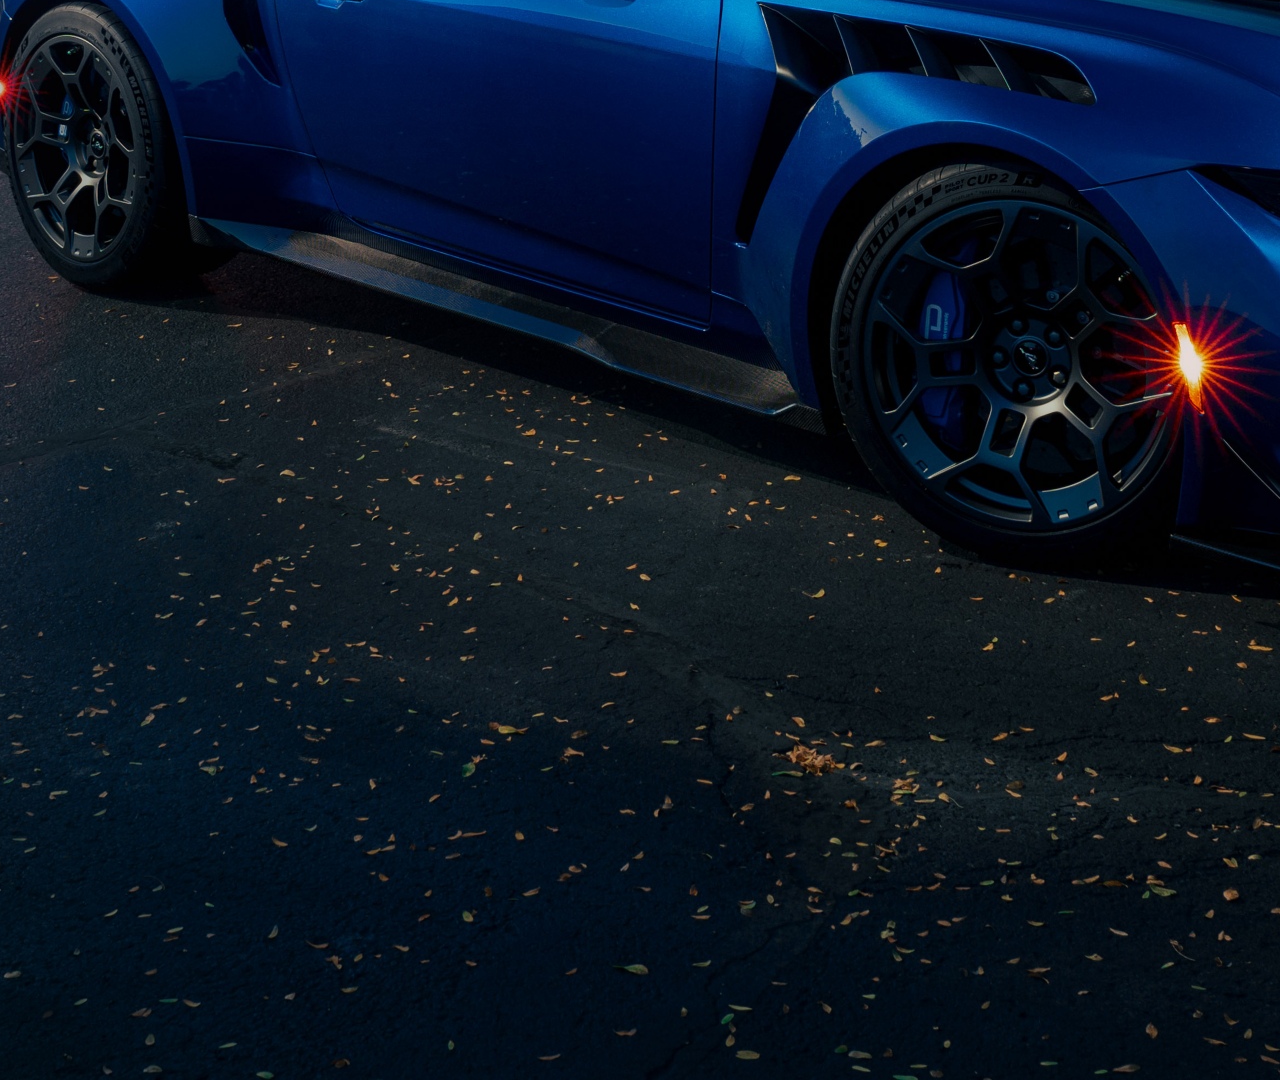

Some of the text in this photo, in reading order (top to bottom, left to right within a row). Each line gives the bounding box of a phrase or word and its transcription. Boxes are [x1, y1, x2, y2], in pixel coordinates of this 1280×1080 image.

[128, 76, 153, 157] MICHELIN
[944, 179, 964, 189] PILOT
[967, 173, 998, 187] CUP
[999, 172, 1010, 184] 2
[945, 185, 964, 194] SPORT
[842, 219, 896, 319] MICHELIN
